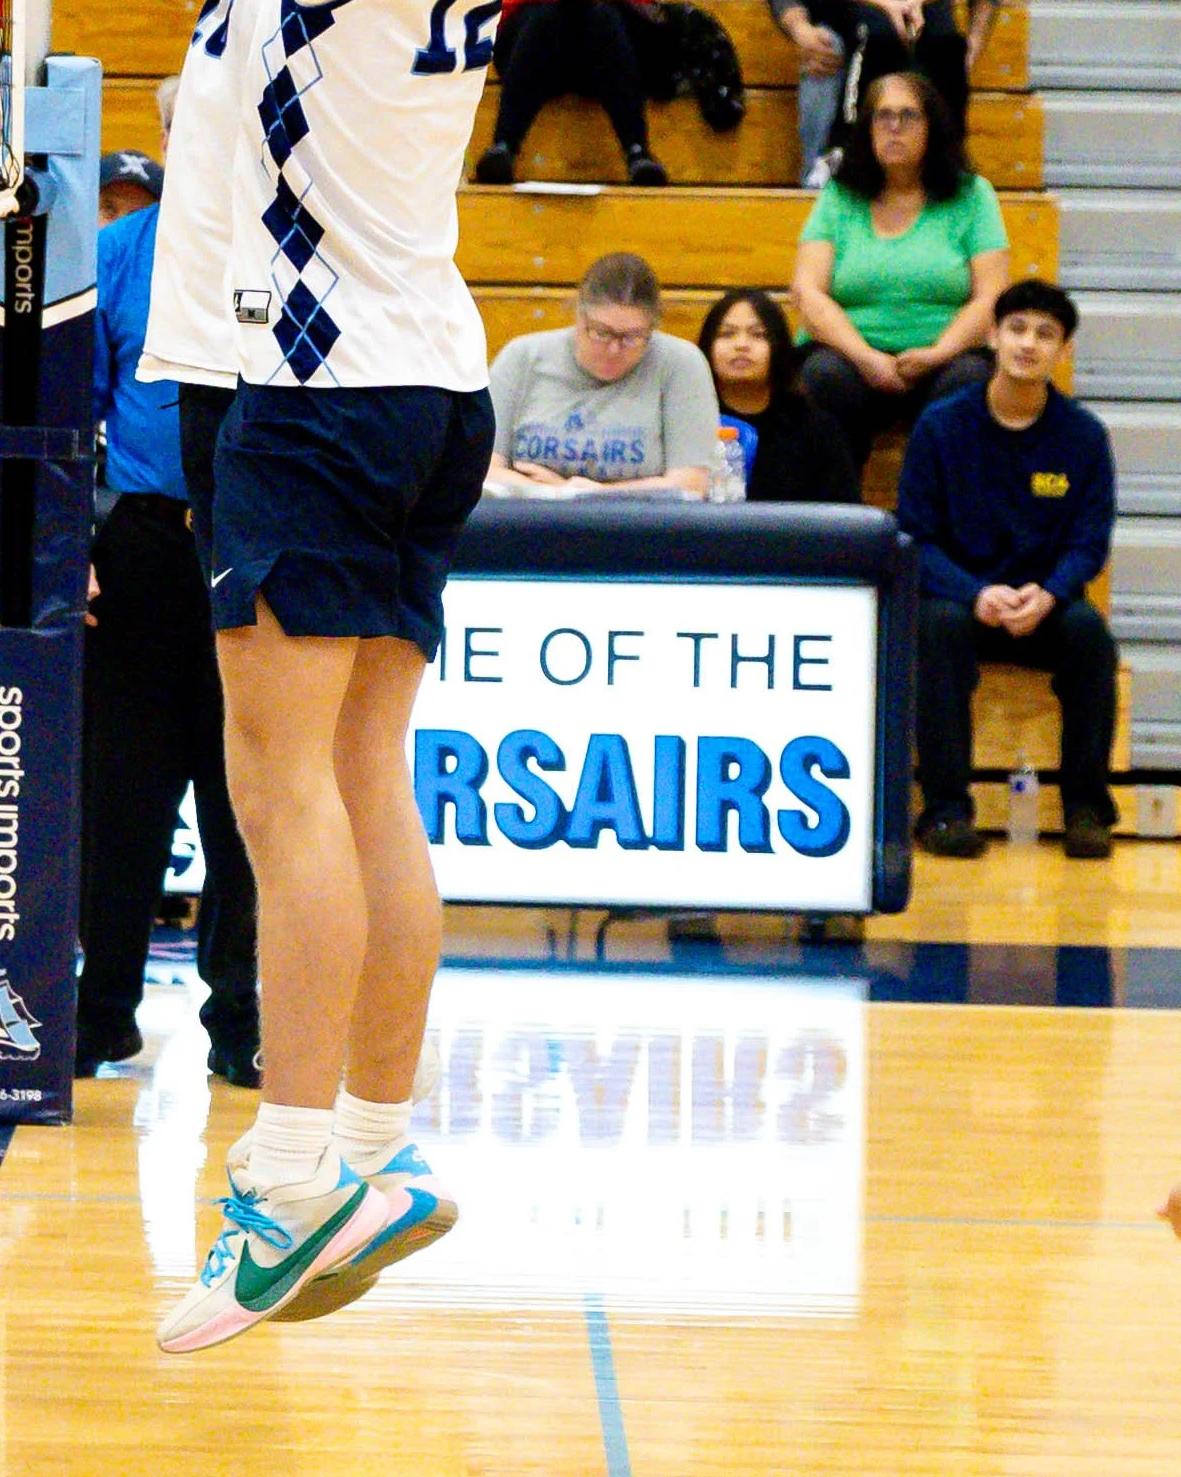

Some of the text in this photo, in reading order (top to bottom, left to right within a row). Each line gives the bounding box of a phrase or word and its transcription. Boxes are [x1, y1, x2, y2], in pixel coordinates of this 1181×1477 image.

[513, 428, 645, 465] CORSAIRS
[539, 627, 645, 686] OF
[676, 631, 833, 692] THE
[414, 728, 851, 858] RSAIRS
